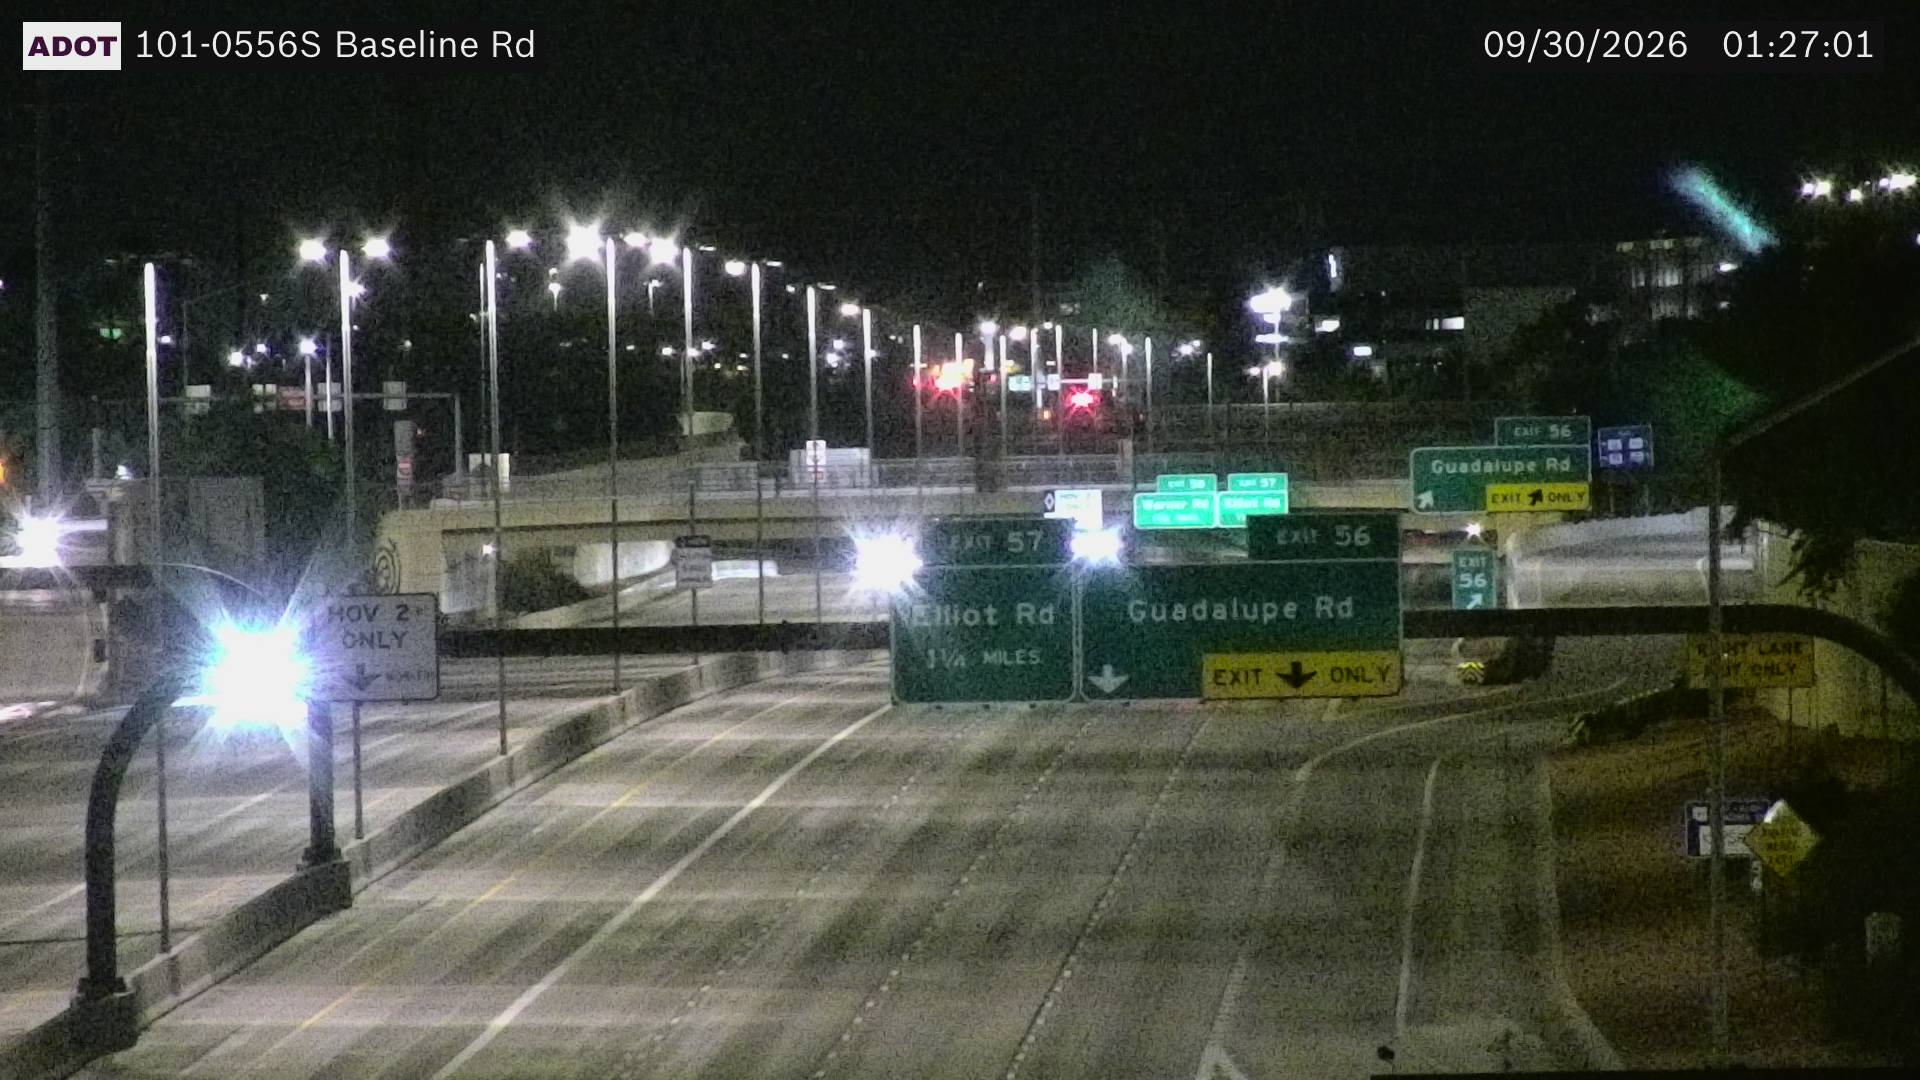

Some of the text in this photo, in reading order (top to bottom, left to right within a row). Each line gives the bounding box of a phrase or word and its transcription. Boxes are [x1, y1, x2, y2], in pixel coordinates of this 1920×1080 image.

[1549, 423, 1573, 438] 56
[1430, 457, 1571, 477] Guadalupe Rd
[1491, 491, 1587, 505] EXIT ONLY
[1007, 530, 1044, 553] 57
[1276, 525, 1372, 547] EXIT 56
[1458, 555, 1487, 569] EXIT
[1458, 572, 1487, 589] 56
[327, 603, 380, 623] HOV
[911, 602, 1055, 626] Elliot Rd
[1128, 594, 1354, 626] Guadalupe Rd
[342, 629, 409, 650] ONLY
[982, 648, 1042, 666] MILES
[1214, 664, 1391, 687] EXIT ONLY
